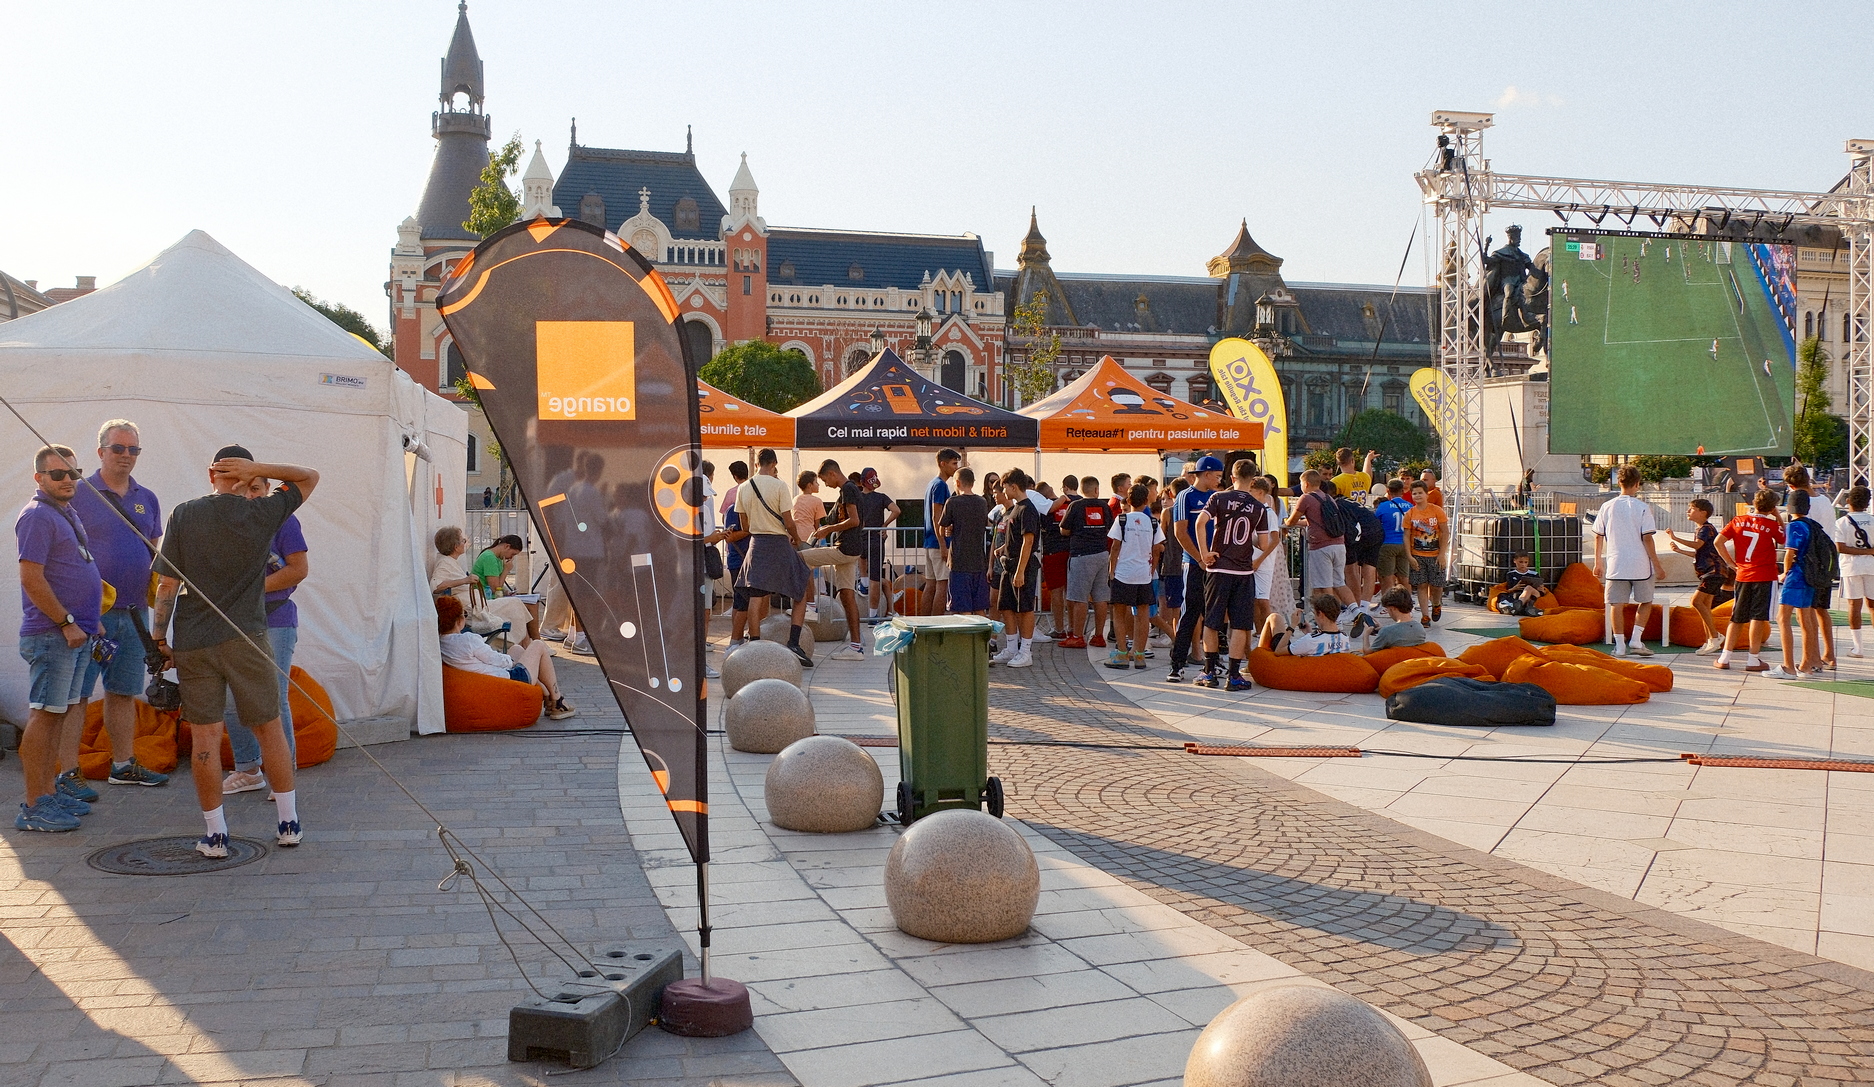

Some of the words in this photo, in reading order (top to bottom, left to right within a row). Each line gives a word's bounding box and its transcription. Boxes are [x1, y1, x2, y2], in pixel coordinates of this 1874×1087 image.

[700, 423, 741, 435] siunile
[744, 424, 767, 436] tale
[827, 426, 848, 438] Cel
[851, 426, 873, 438] mai
[876, 426, 907, 440] rapid
[910, 427, 930, 438] net
[933, 427, 965, 438] mobil
[968, 427, 978, 438] &
[981, 427, 1007, 438] fibră
[1128, 429, 1165, 441] pentru
[1167, 428, 1217, 441] pasiunile
[1219, 429, 1240, 439] tale
[1392, 511, 1405, 533] 1
[1735, 521, 1771, 534] RONALDO
[1223, 516, 1251, 546] 10
[1742, 530, 1760, 563] 7
